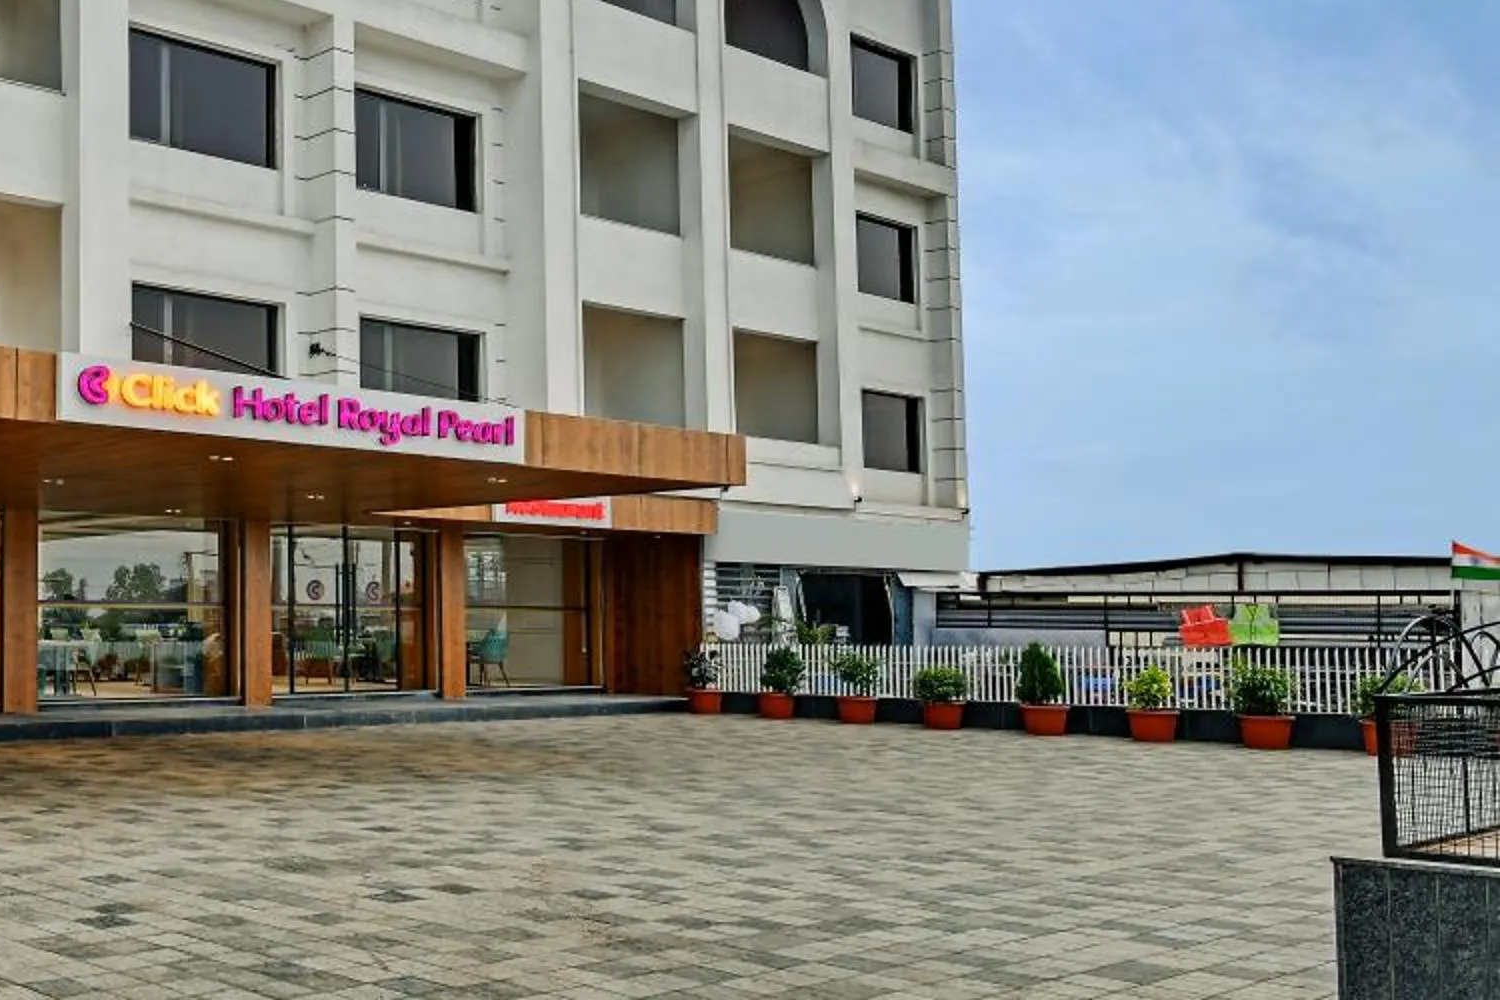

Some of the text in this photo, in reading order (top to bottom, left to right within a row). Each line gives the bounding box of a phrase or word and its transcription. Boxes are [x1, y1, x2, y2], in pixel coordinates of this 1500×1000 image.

[120, 373, 221, 416] Click
[232, 386, 329, 426] Hotel
[337, 397, 432, 446] Royal
[438, 410, 515, 446] Pearl
